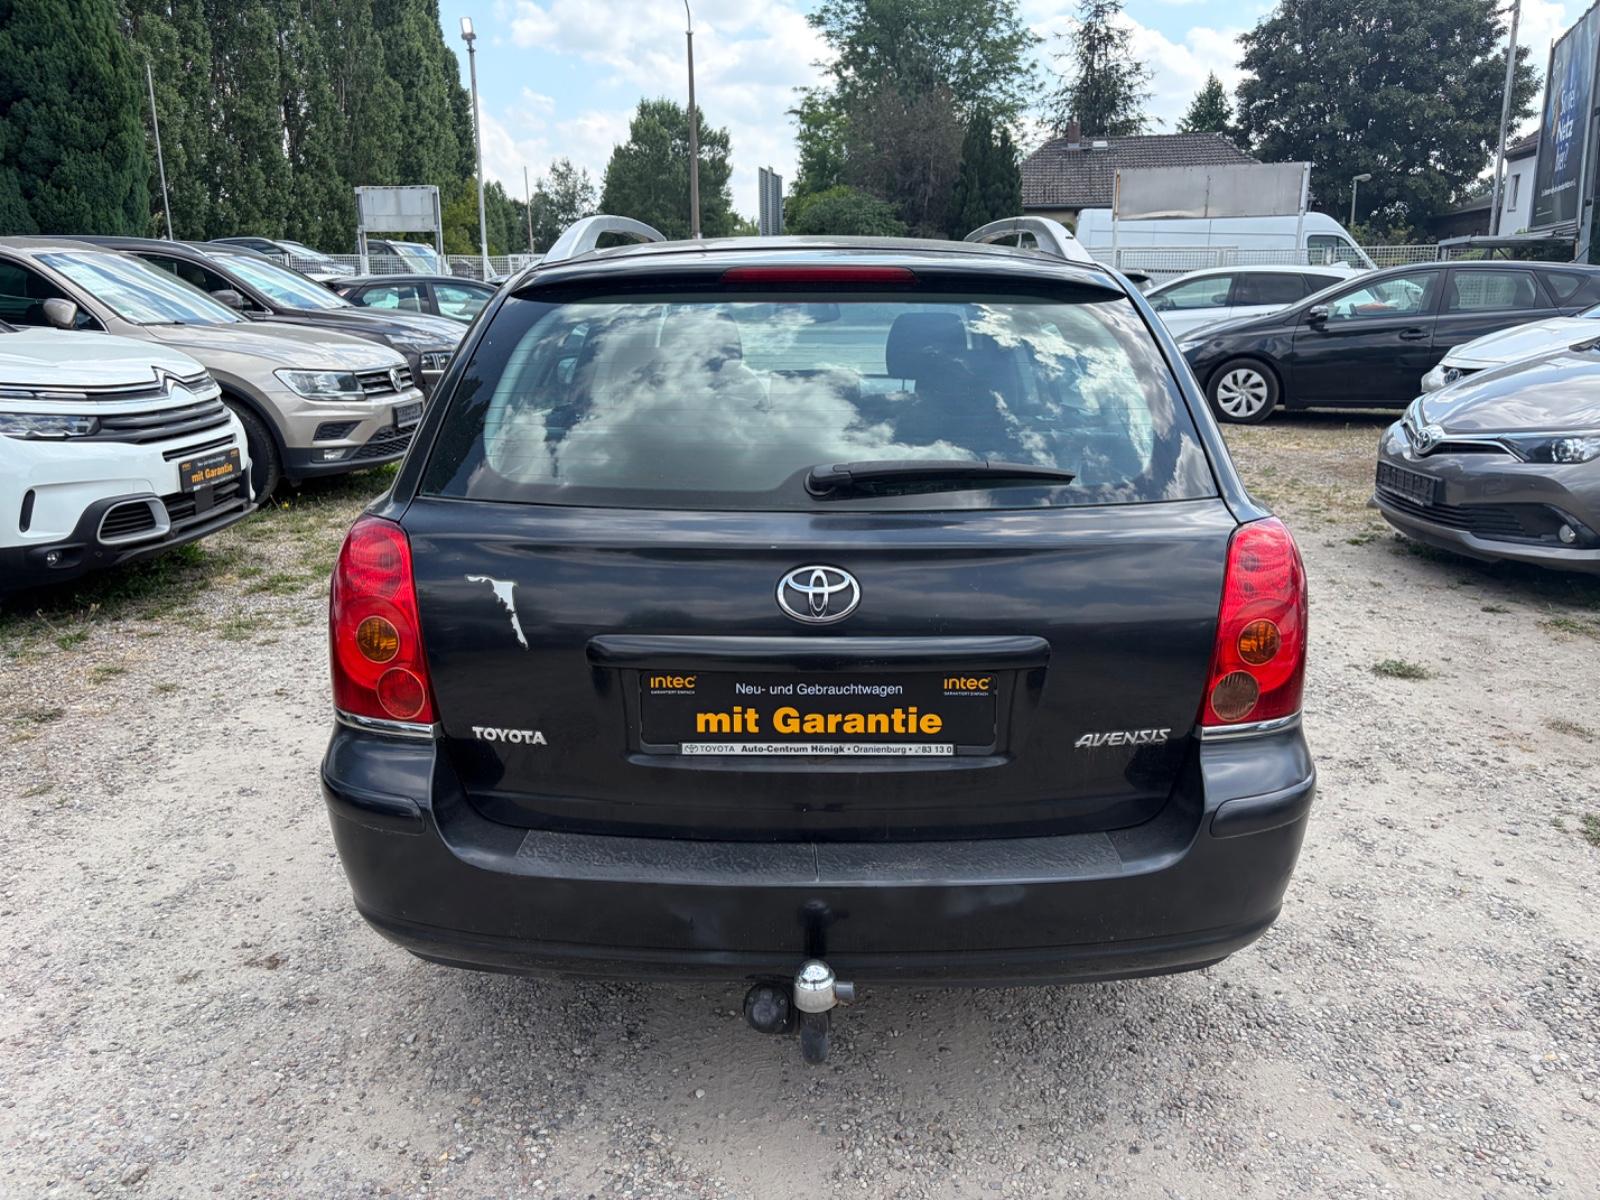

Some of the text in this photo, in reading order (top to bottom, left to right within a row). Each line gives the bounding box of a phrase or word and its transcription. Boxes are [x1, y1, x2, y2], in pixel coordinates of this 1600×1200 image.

[191, 470, 204, 484] mit
[204, 463, 233, 479] Garantie
[650, 675, 696, 689] intec
[735, 682, 903, 698] Neu- und Gebrauchtwagen
[943, 677, 990, 690] intec
[696, 705, 943, 734] mit Garantie
[472, 726, 549, 746] TOYOTA
[1074, 728, 1172, 748] AVENSIS
[700, 744, 735, 753] TOYOTA
[741, 744, 809, 753] Auto-Centrum
[811, 744, 845, 755] Hönigk
[852, 744, 907, 756] Oranienburg
